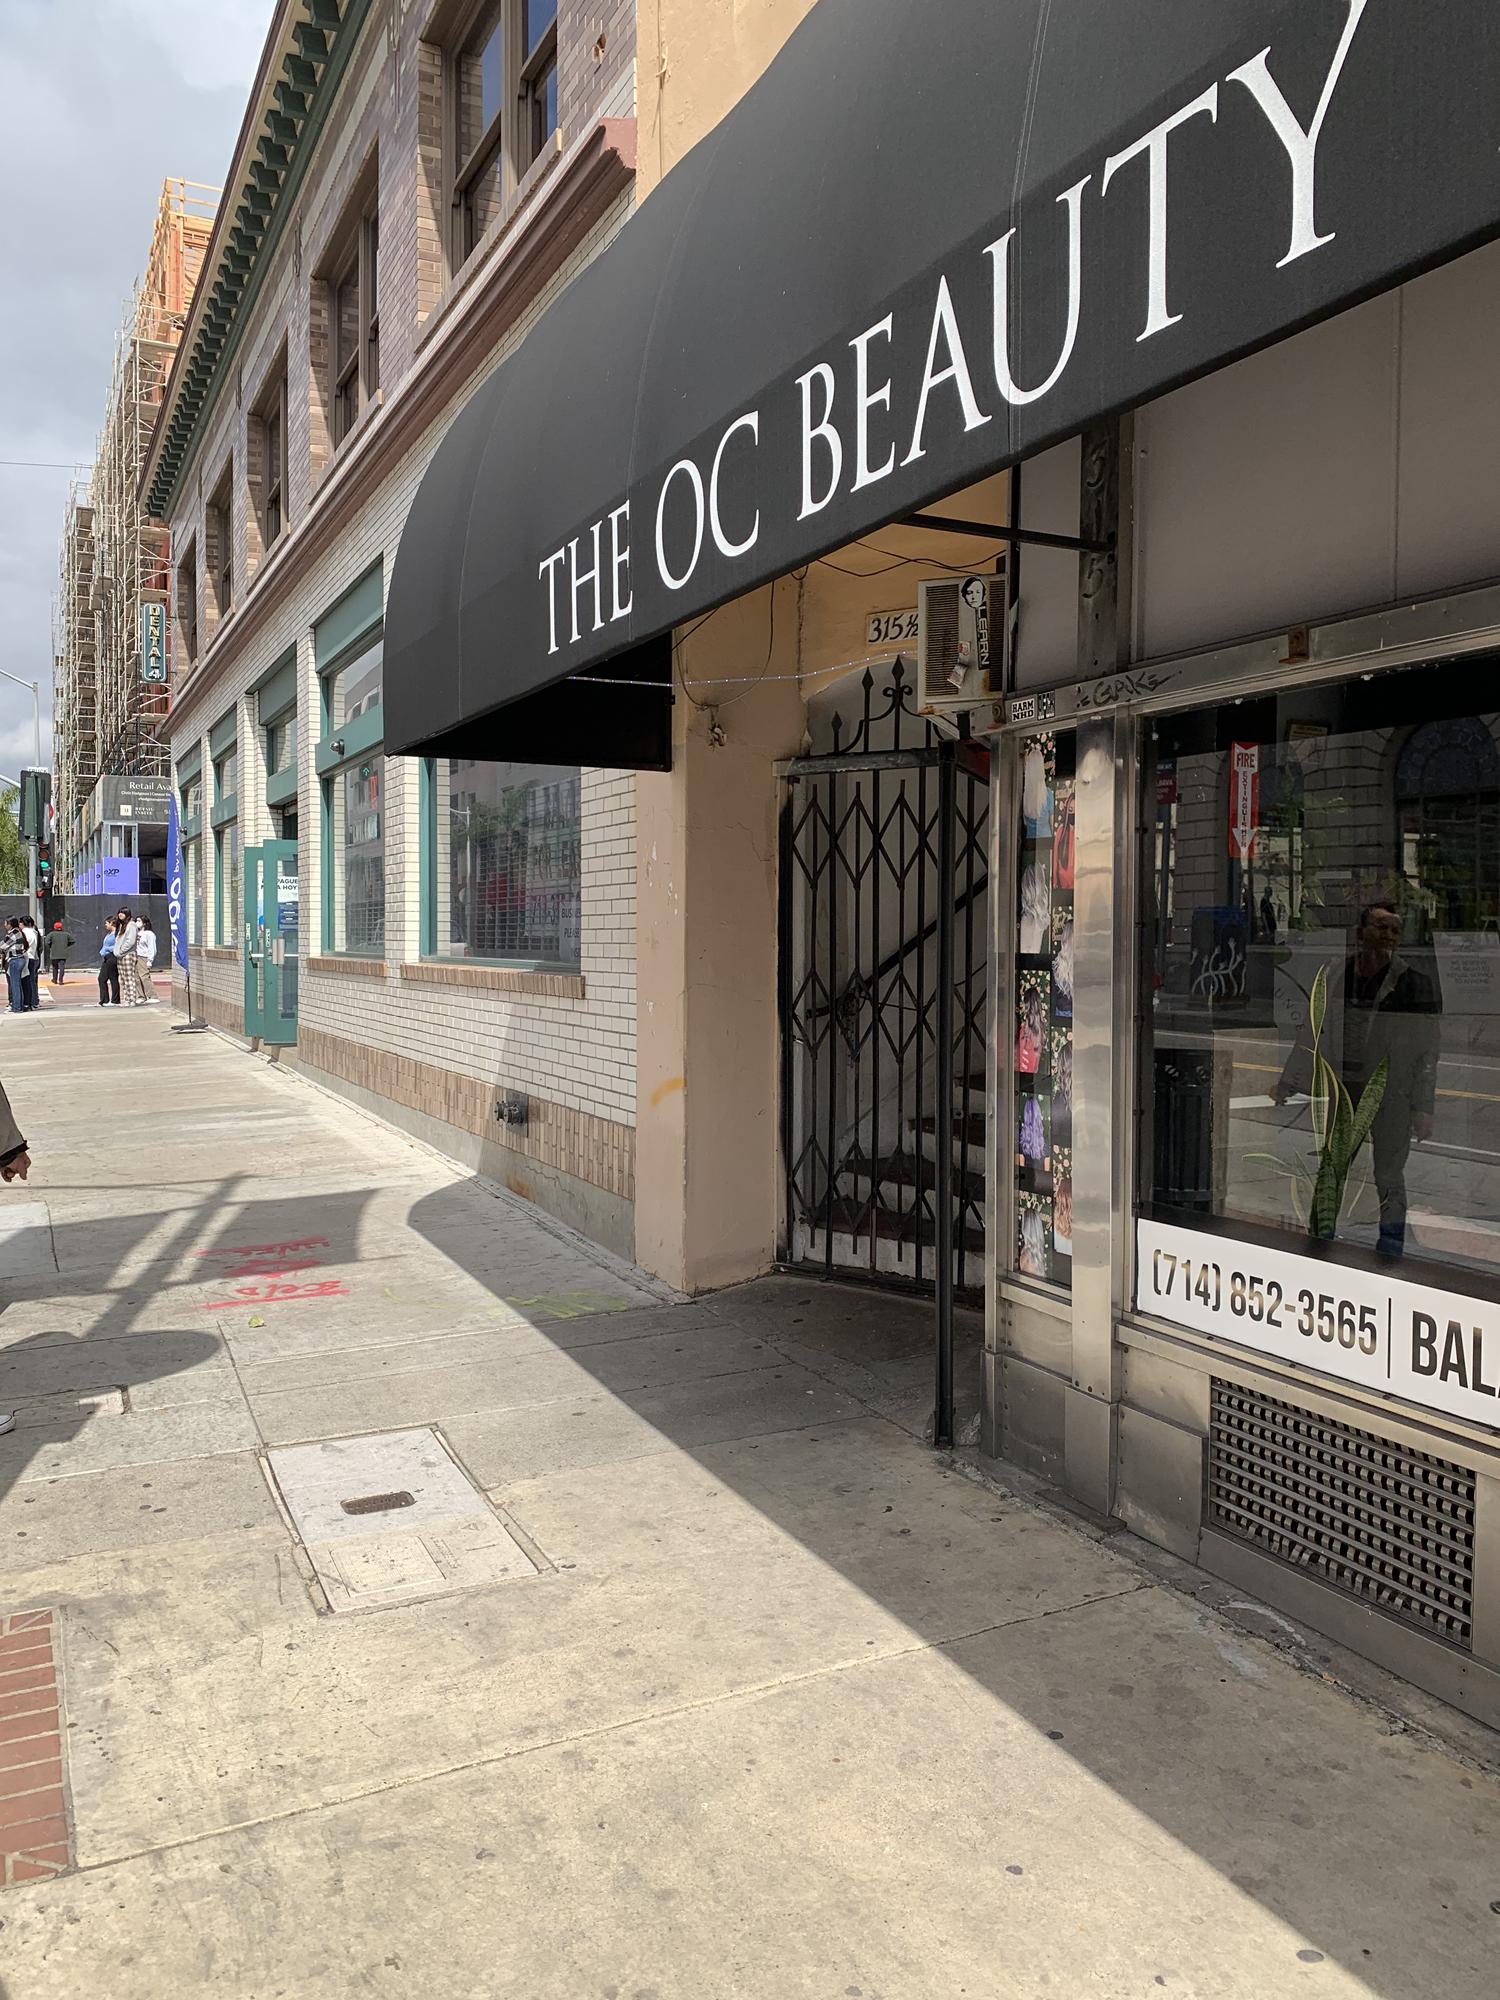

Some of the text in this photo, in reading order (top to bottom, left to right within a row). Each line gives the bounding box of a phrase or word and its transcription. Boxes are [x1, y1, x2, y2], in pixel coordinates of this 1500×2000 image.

[538, 0, 1368, 655] THE OC BEAUTY
[149, 604, 161, 667] DENTAL
[868, 612, 904, 643] 315
[978, 605, 990, 665] LEARN
[1012, 699, 1034, 713] HARM
[1012, 709, 1034, 721] NHD
[1236, 752, 1255, 768] FIRE
[129, 781, 154, 790] Retail
[1153, 1248, 1500, 1399] (714) 852-3565 BAL
